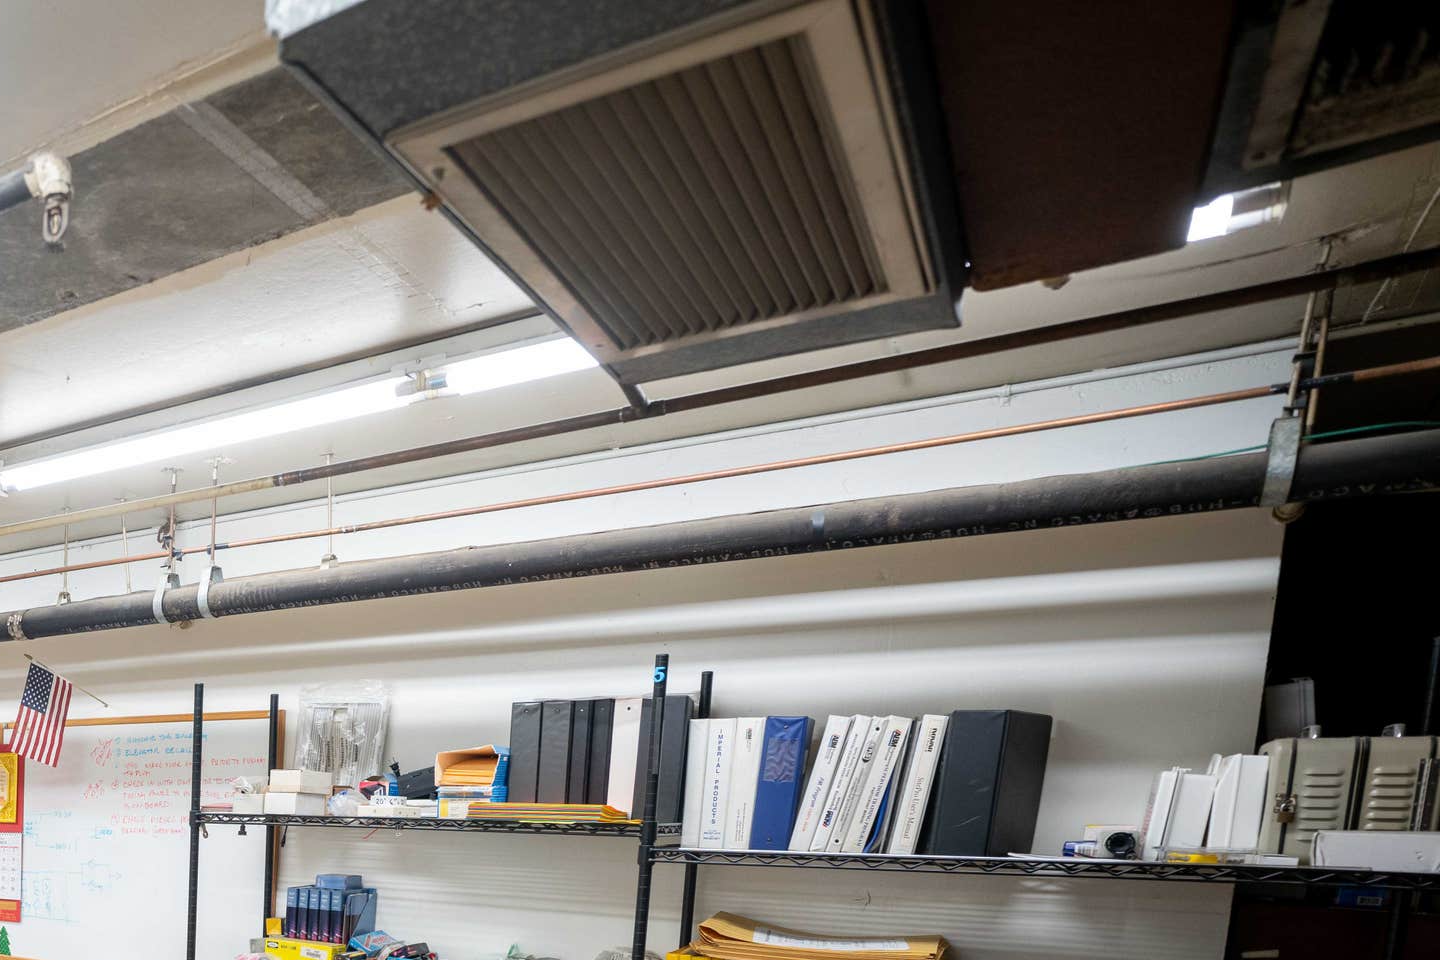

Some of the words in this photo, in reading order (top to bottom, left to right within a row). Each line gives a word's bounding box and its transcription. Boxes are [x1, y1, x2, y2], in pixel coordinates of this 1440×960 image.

[654, 666, 666, 683] 5
[716, 728, 724, 774] IMPERIAL
[711, 780, 720, 825] PRODUCTS
[903, 816, 915, 840] Manual
